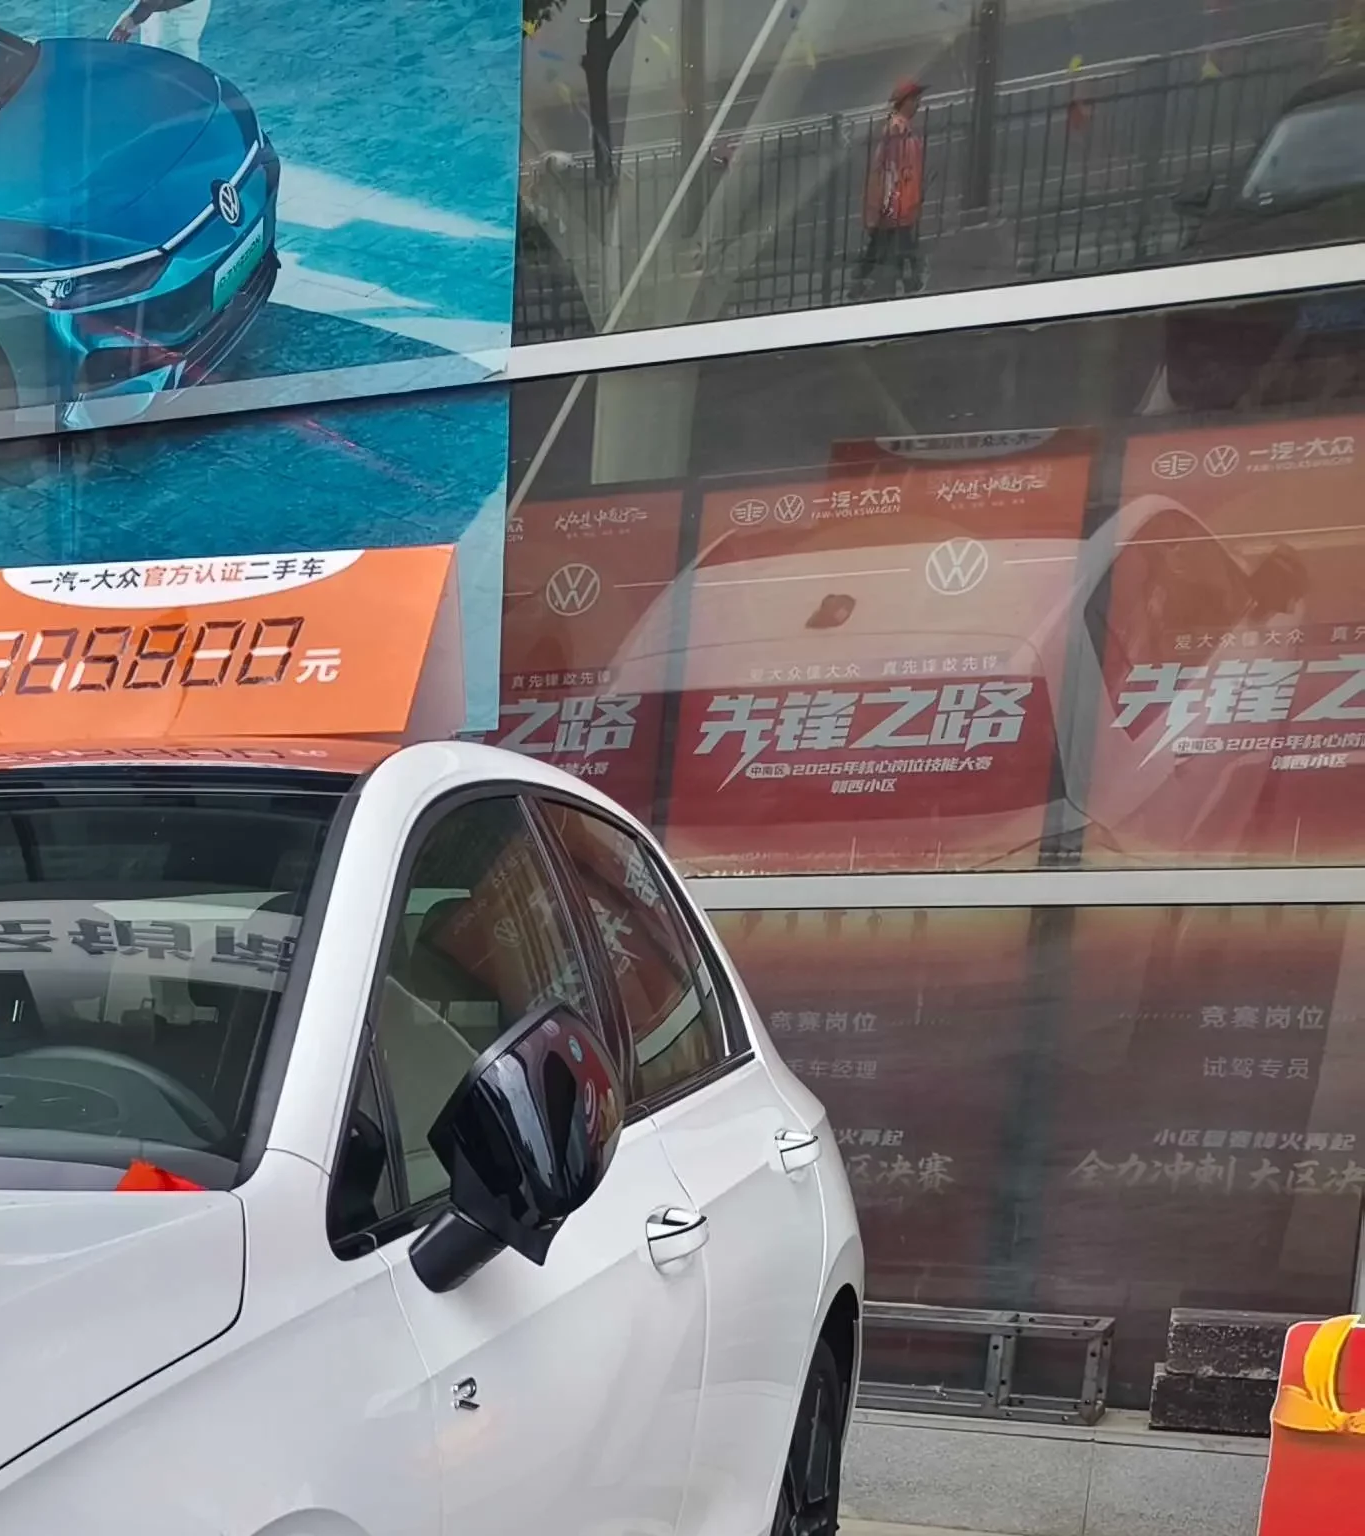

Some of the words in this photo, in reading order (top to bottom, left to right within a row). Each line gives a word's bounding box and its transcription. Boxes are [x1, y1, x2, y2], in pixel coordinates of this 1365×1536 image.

[693, 681, 1033, 792] 先锋之路
[1202, 1056, 1311, 1080] 试驾专员
